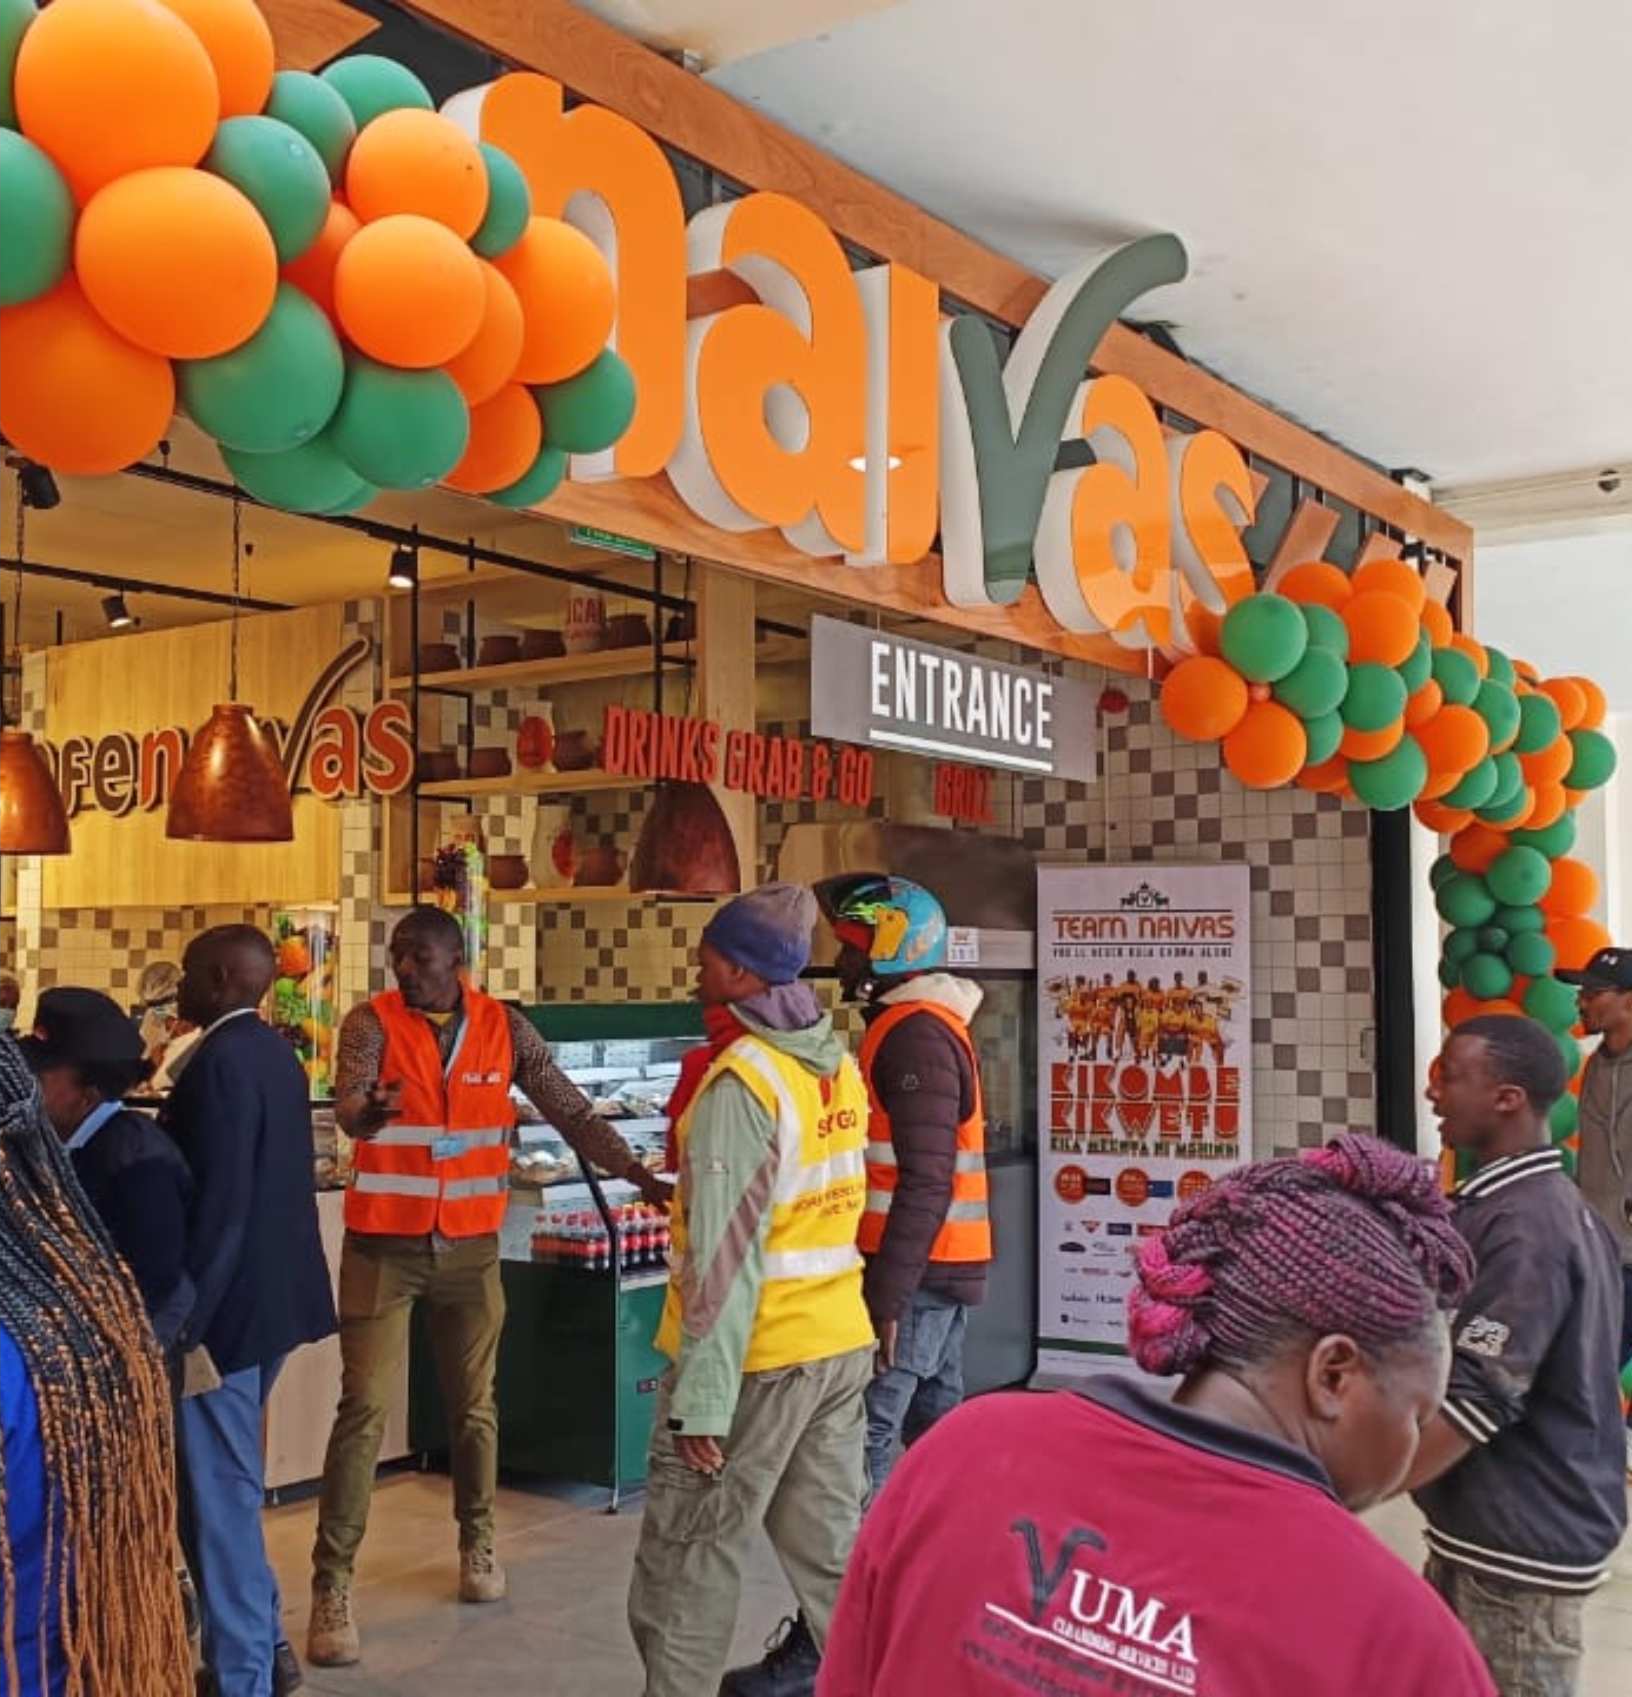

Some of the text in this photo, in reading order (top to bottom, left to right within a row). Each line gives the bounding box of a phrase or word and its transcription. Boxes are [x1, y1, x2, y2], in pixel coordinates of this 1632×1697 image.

[448, 70, 1256, 662] naivas
[871, 640, 1053, 750] ENTRANCE
[604, 705, 875, 808] DRINKS GRAB & GO
[1052, 916, 1235, 939] TEAM NAIVAS
[1050, 1063, 1240, 1102] KIKOMBE
[1050, 1101, 1240, 1139] KIKWETU
[1457, 1315, 1510, 1356] 23
